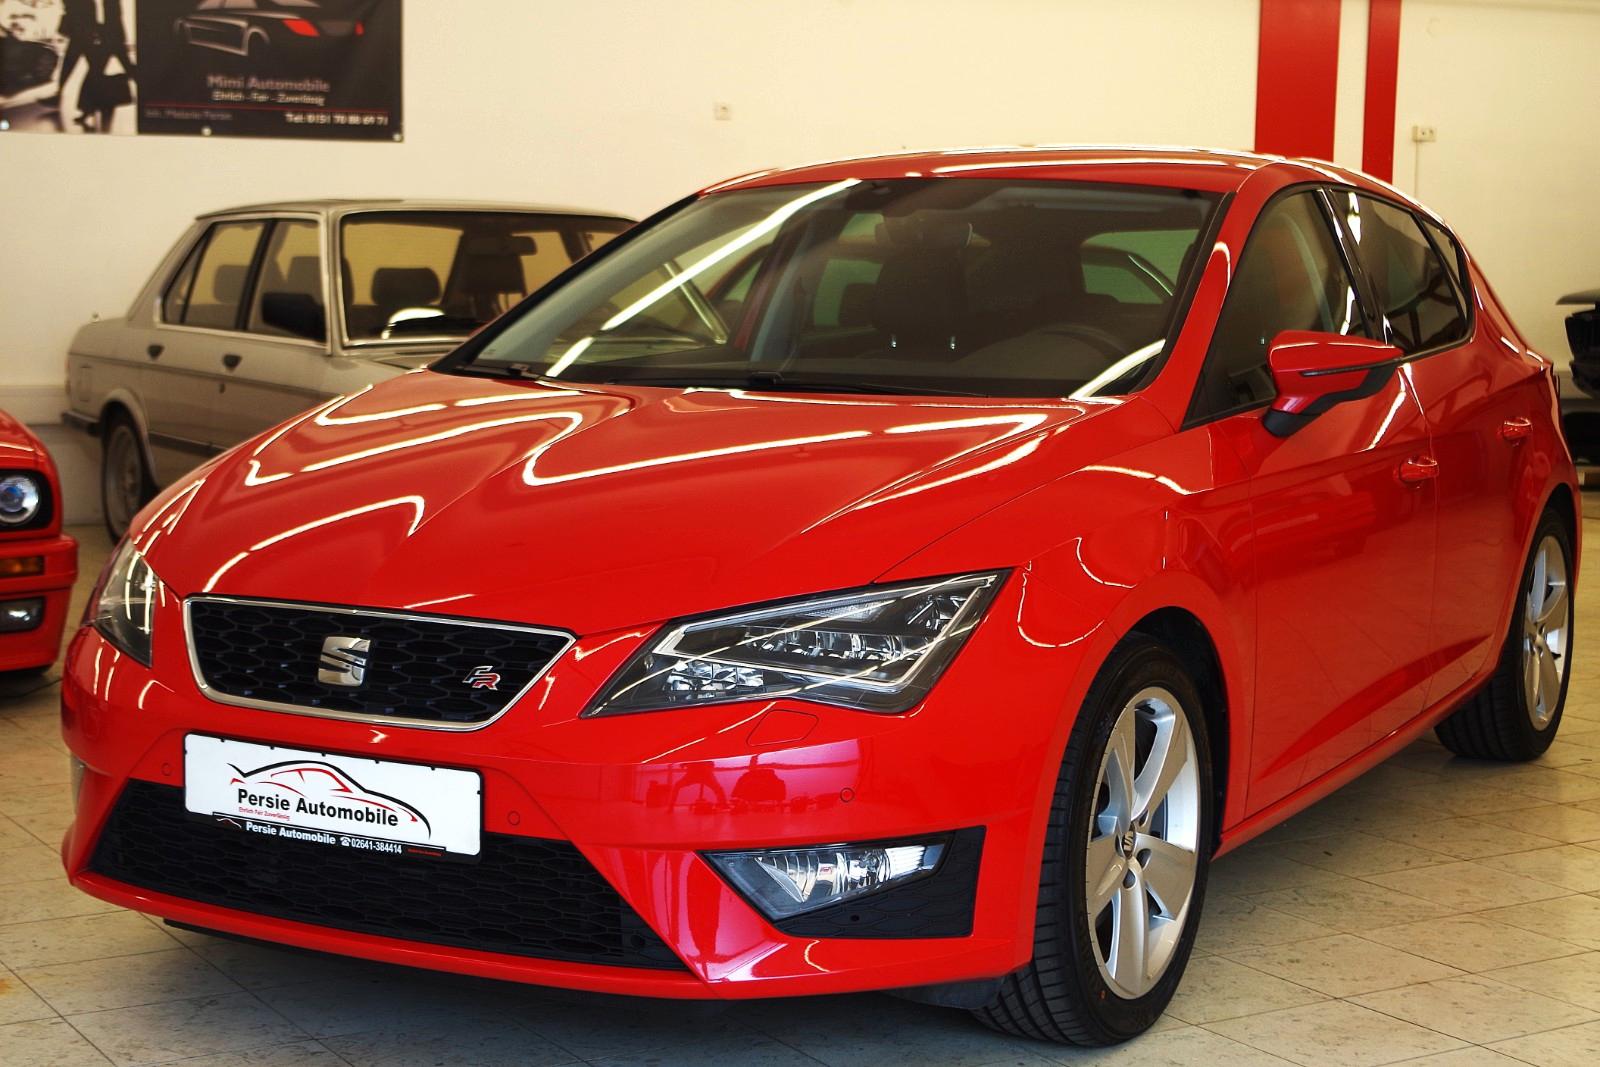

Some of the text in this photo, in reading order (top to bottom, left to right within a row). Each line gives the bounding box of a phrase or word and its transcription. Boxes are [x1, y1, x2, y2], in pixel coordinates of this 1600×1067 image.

[248, 77, 330, 92] Automobile
[462, 666, 501, 691] FR
[237, 788, 399, 826] Persie Automobile
[246, 821, 277, 835] Persie
[279, 827, 336, 844] Automobile
